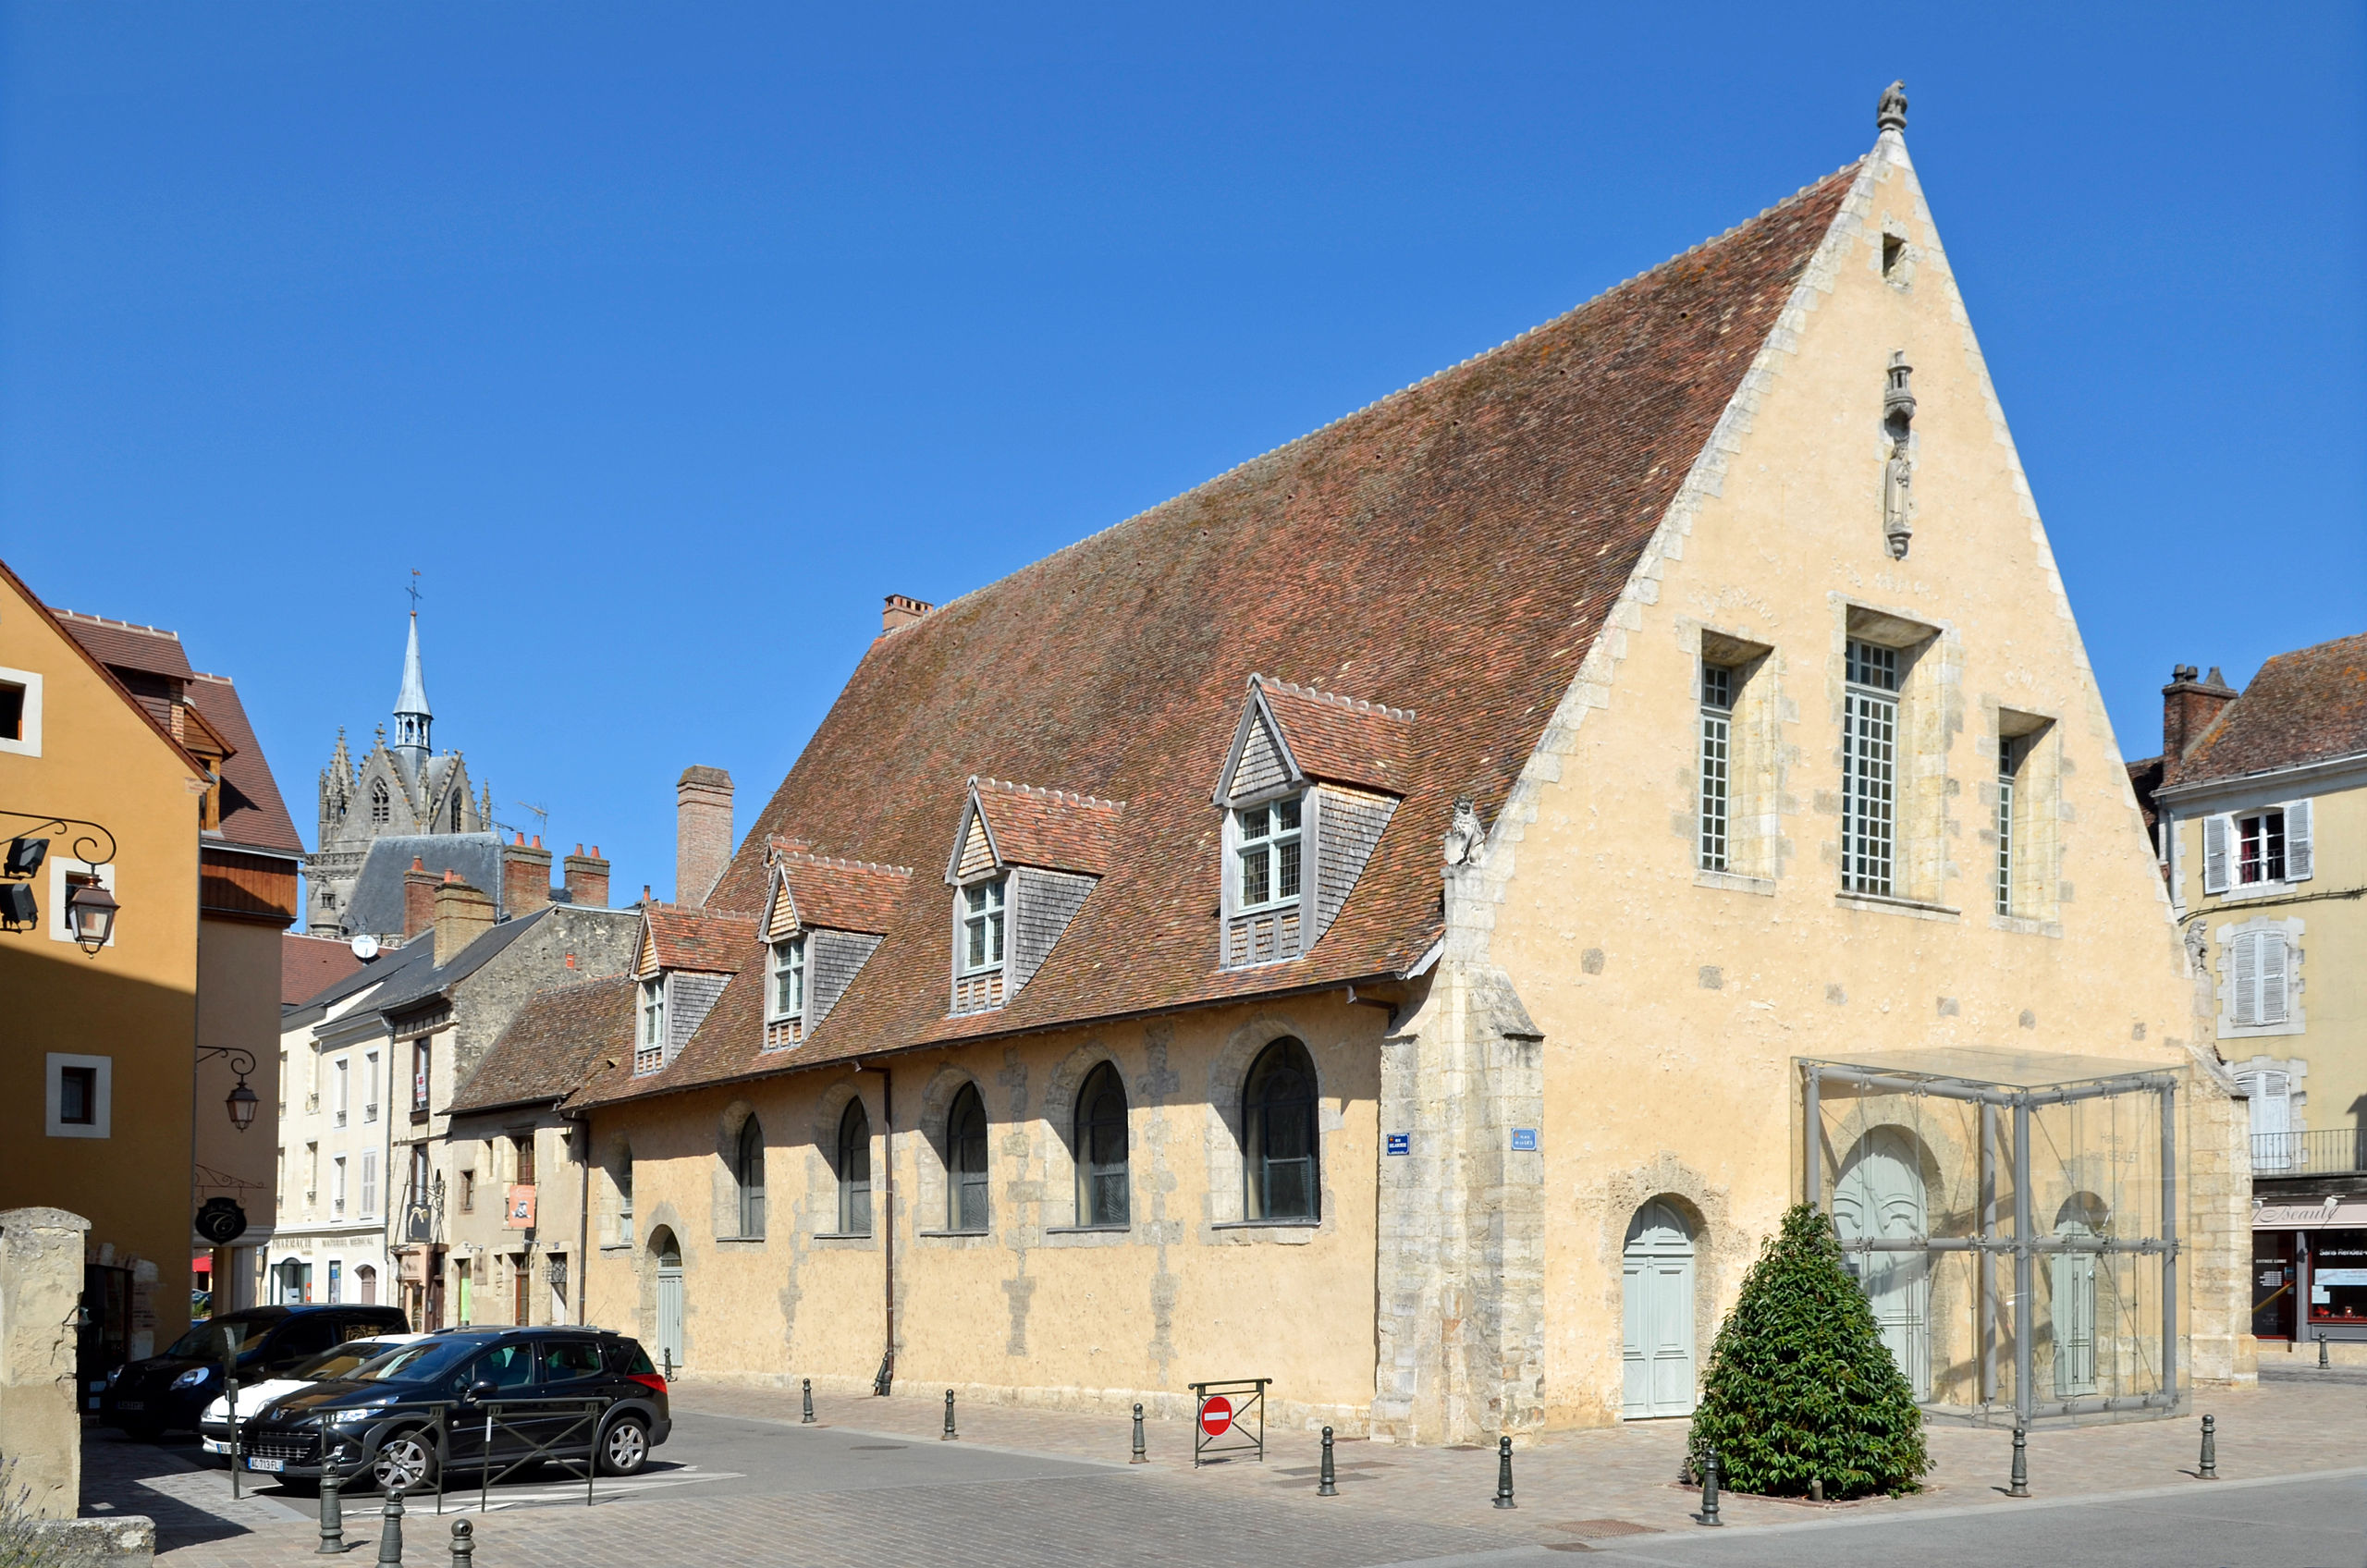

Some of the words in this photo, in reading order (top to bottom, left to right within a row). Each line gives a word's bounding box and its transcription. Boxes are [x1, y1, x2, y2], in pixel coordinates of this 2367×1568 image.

[2100, 1132, 2123, 1145] Halles
[272, 1237, 313, 1250] PHARMACIE
[2319, 1248, 2337, 1256] Sans
